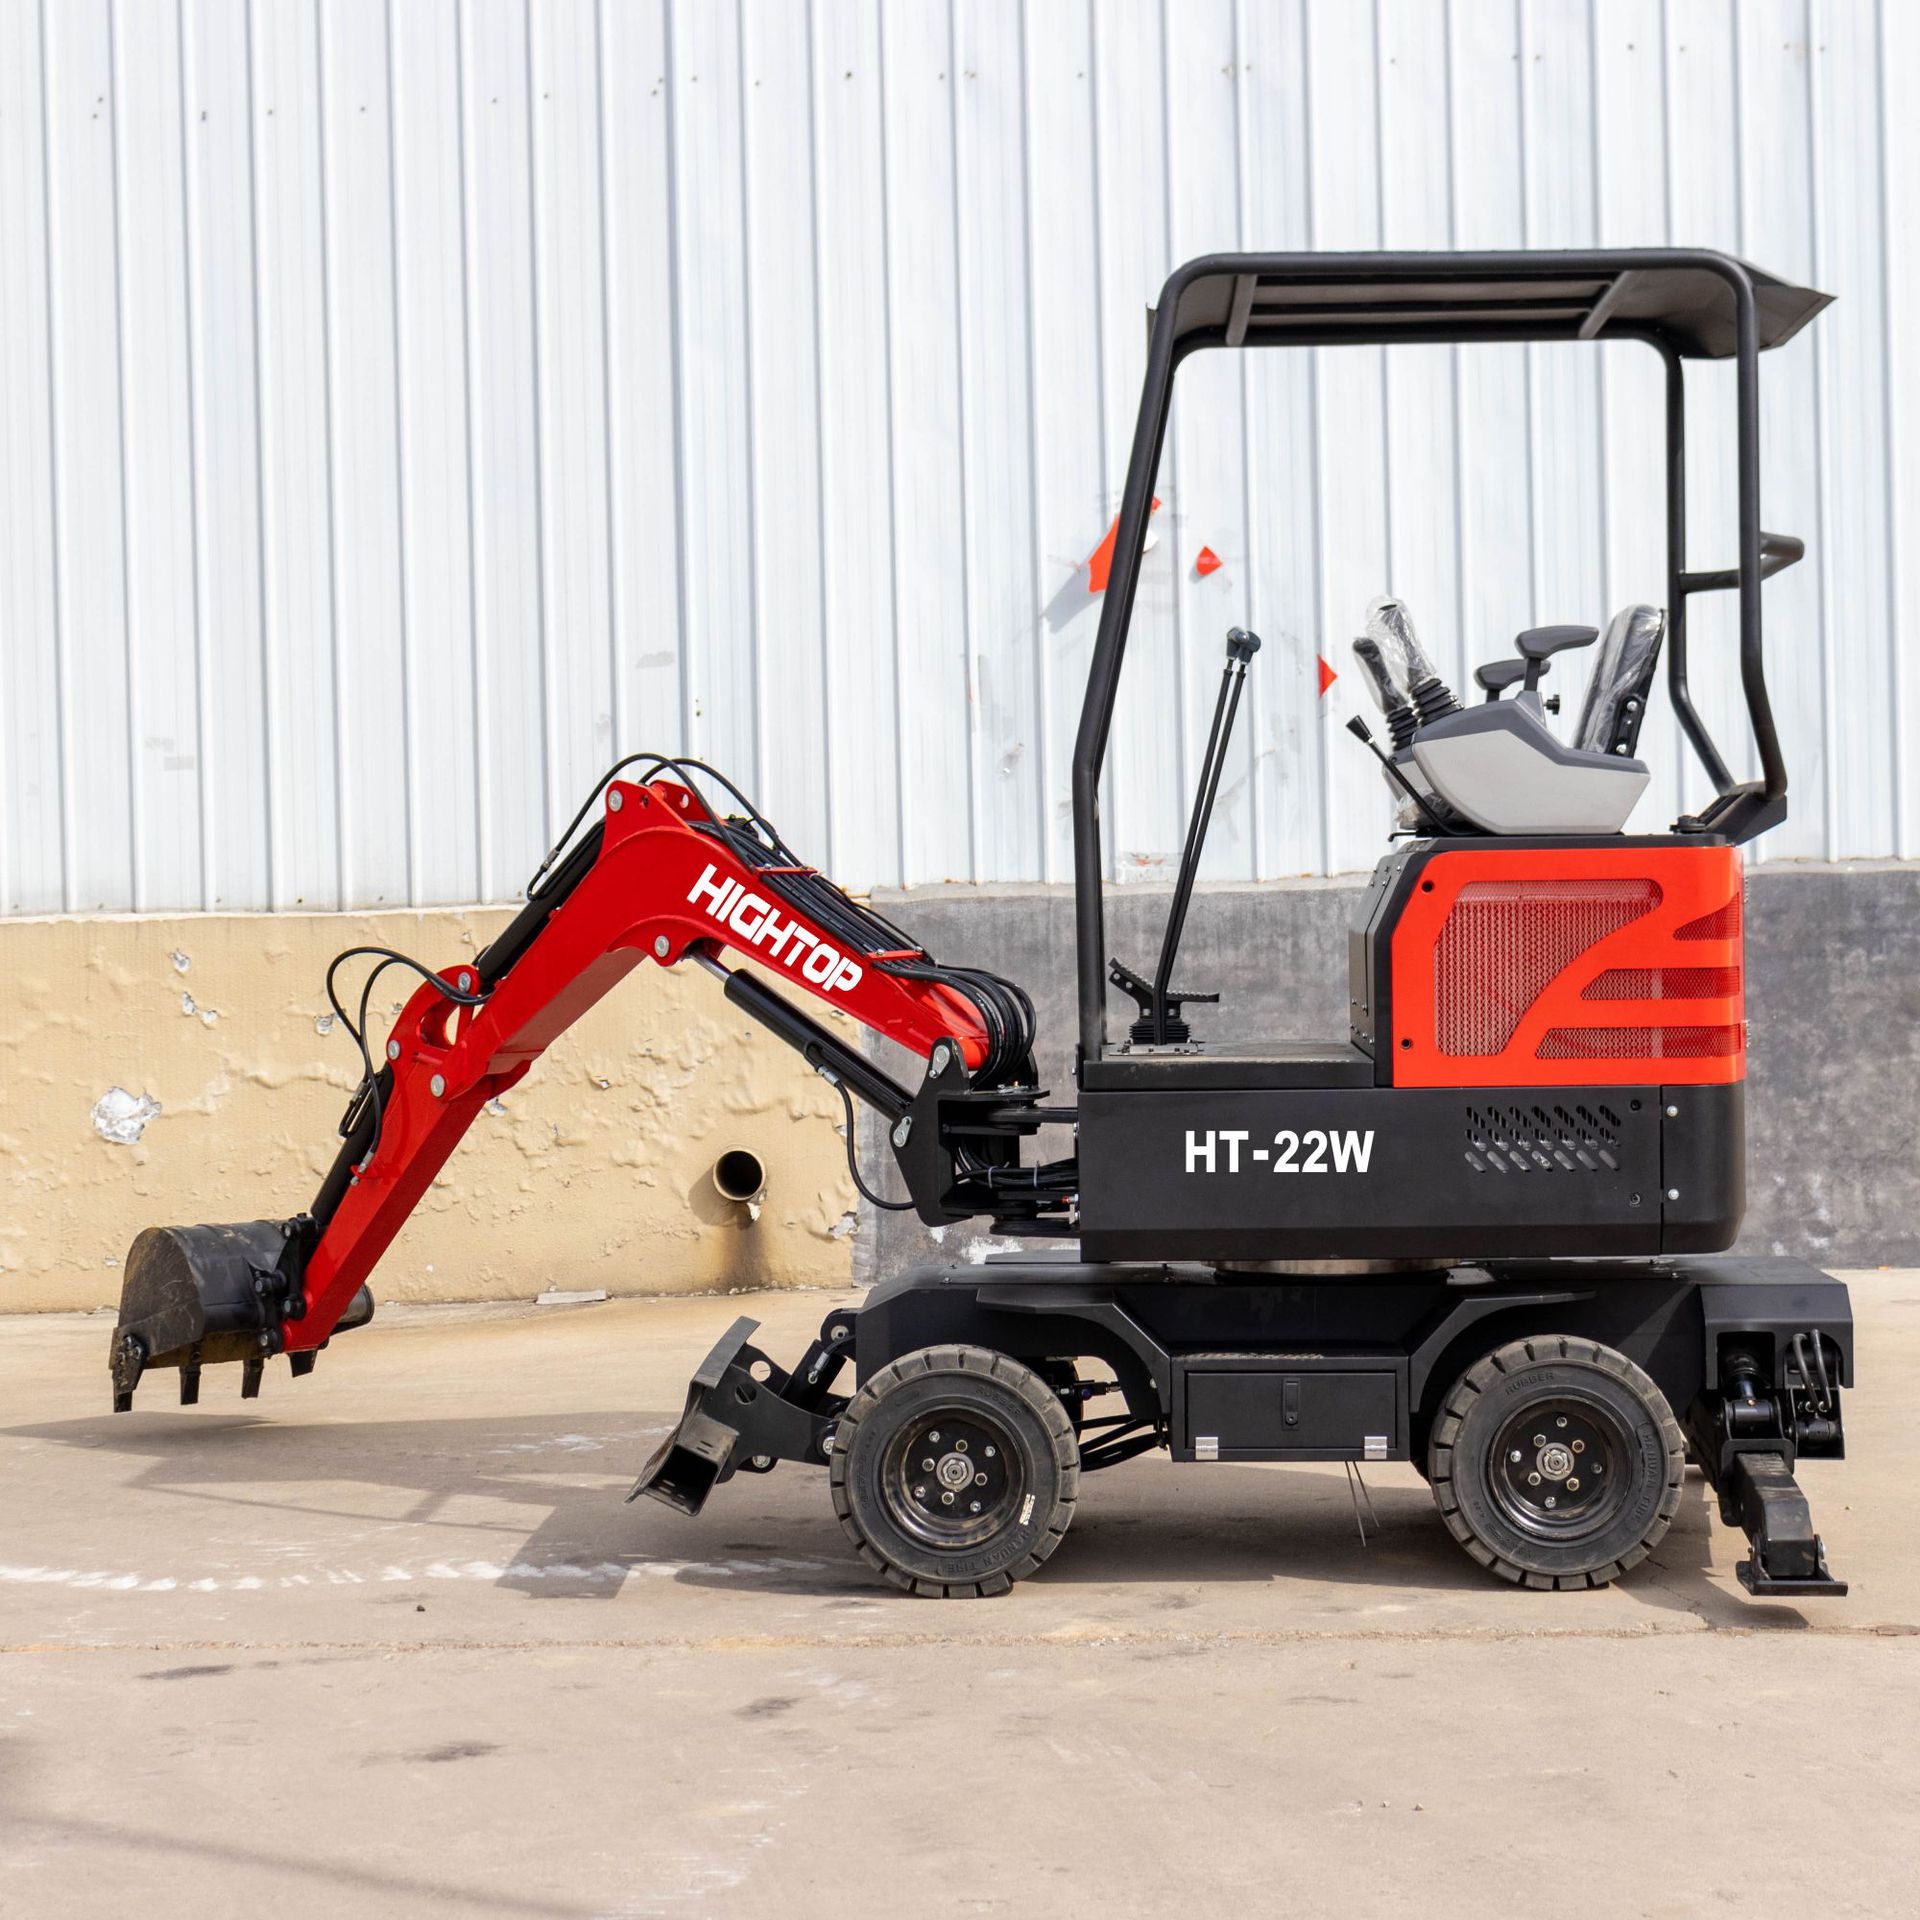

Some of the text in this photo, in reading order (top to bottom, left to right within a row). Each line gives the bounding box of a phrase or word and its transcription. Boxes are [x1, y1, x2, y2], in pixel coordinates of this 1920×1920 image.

[686, 863, 863, 992] HIGHTOP
[1185, 1130, 1375, 1173] HT-22W
[947, 1560, 977, 1574] TIRE
